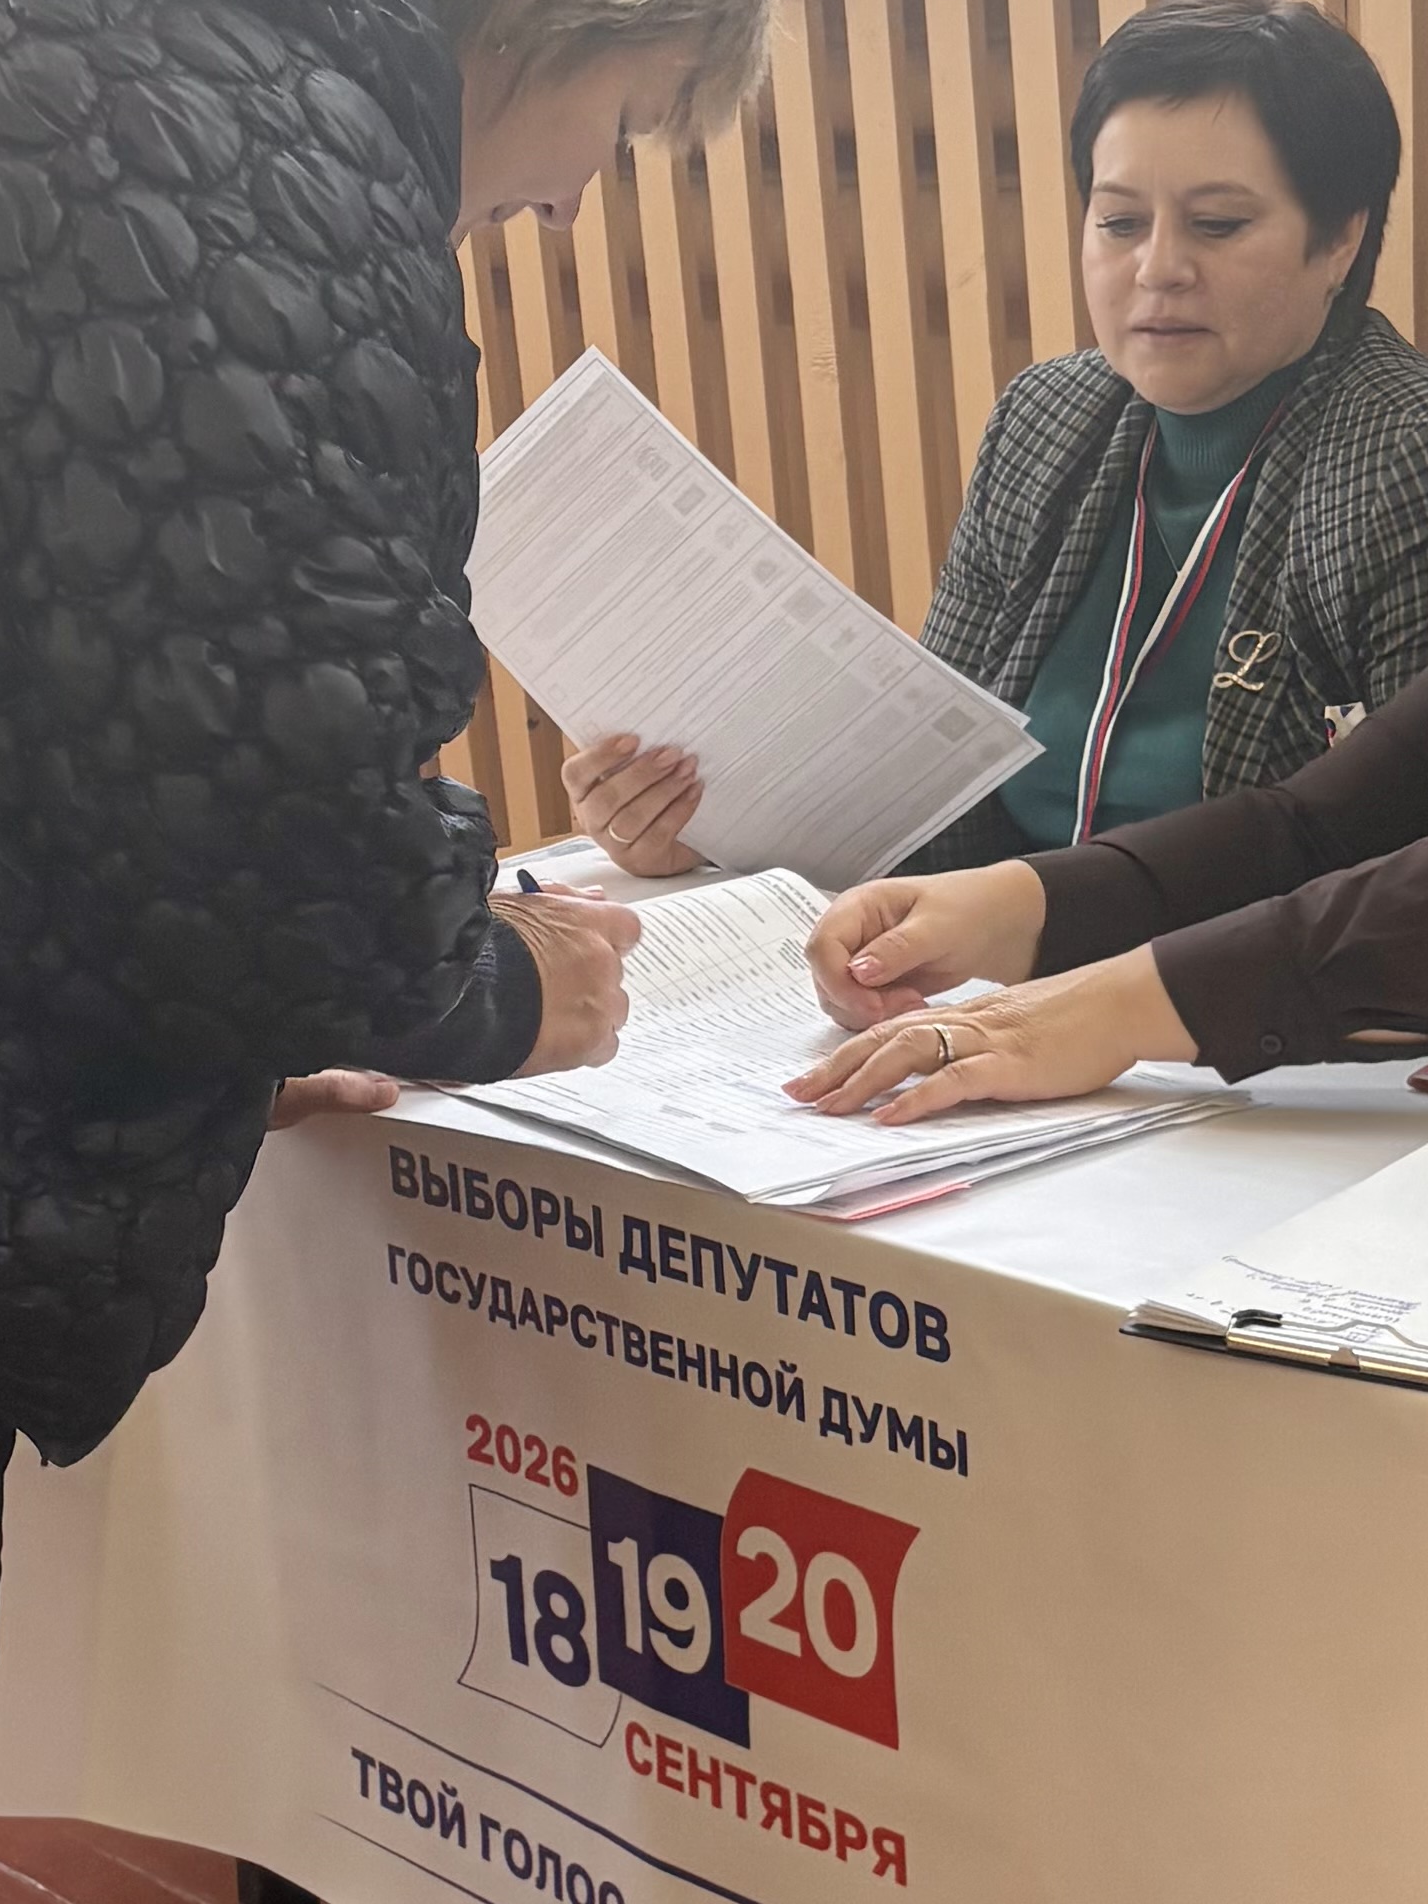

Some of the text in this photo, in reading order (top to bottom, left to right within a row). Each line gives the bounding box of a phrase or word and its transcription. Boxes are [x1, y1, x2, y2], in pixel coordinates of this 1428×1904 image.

[388, 1144, 952, 1364] ВЫБОРЫ ДЕПУТАТОВ
[386, 1243, 969, 1478] ГОСУДАРСТВЕННОЙ ДУМЫ
[465, 1413, 580, 1498] 2026
[489, 1526, 879, 1688] 18 19 20
[350, 1746, 467, 1850] ТВОЙ
[624, 1721, 908, 1888] СЕНТЯБРЯ
